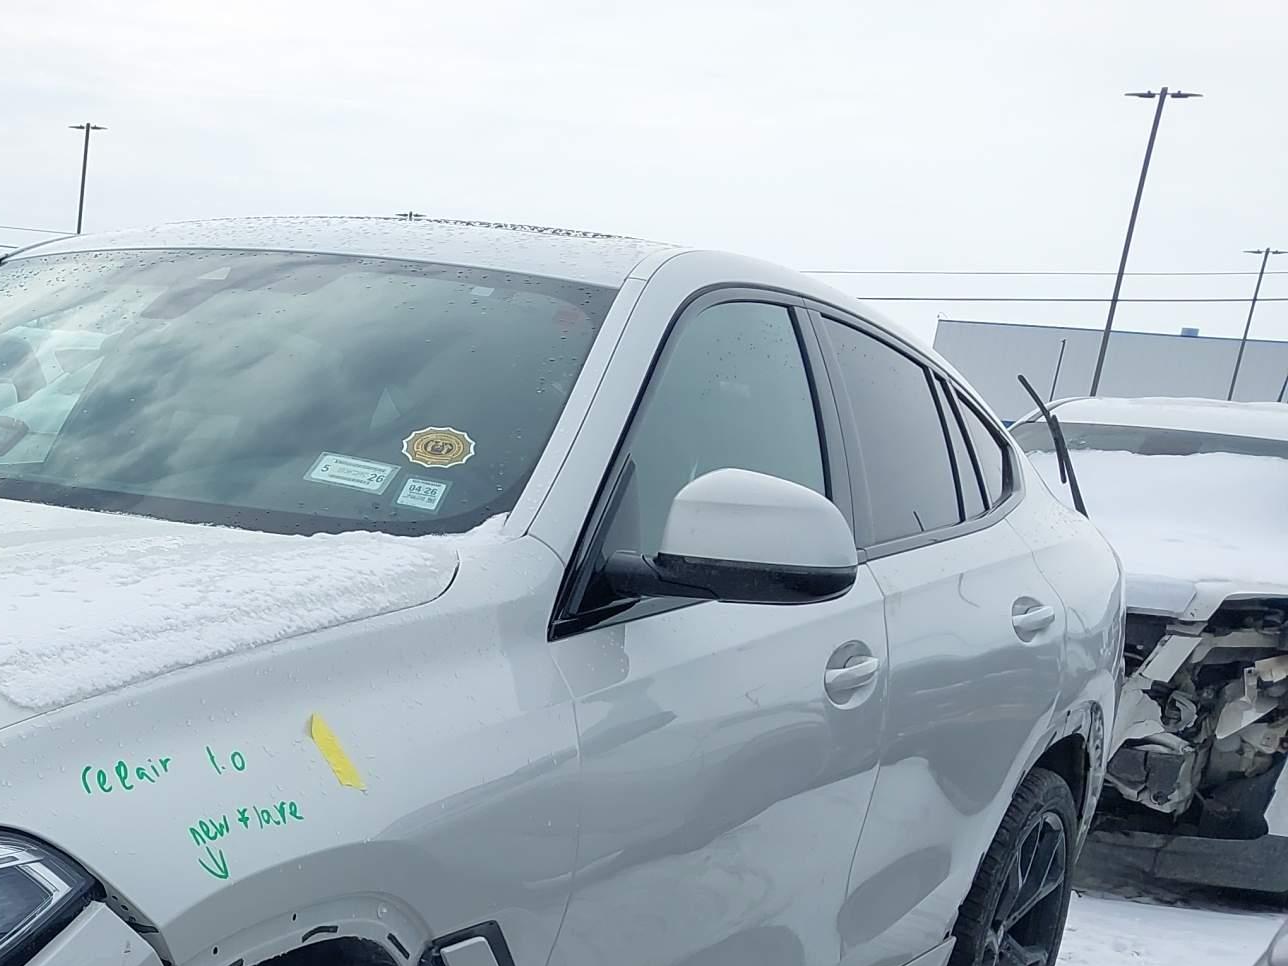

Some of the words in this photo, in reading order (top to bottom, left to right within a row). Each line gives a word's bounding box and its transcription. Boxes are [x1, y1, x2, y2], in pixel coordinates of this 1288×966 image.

[320, 464, 331, 473] 5
[367, 473, 385, 483] 26
[81, 757, 171, 794] repair
[188, 815, 230, 846] new
